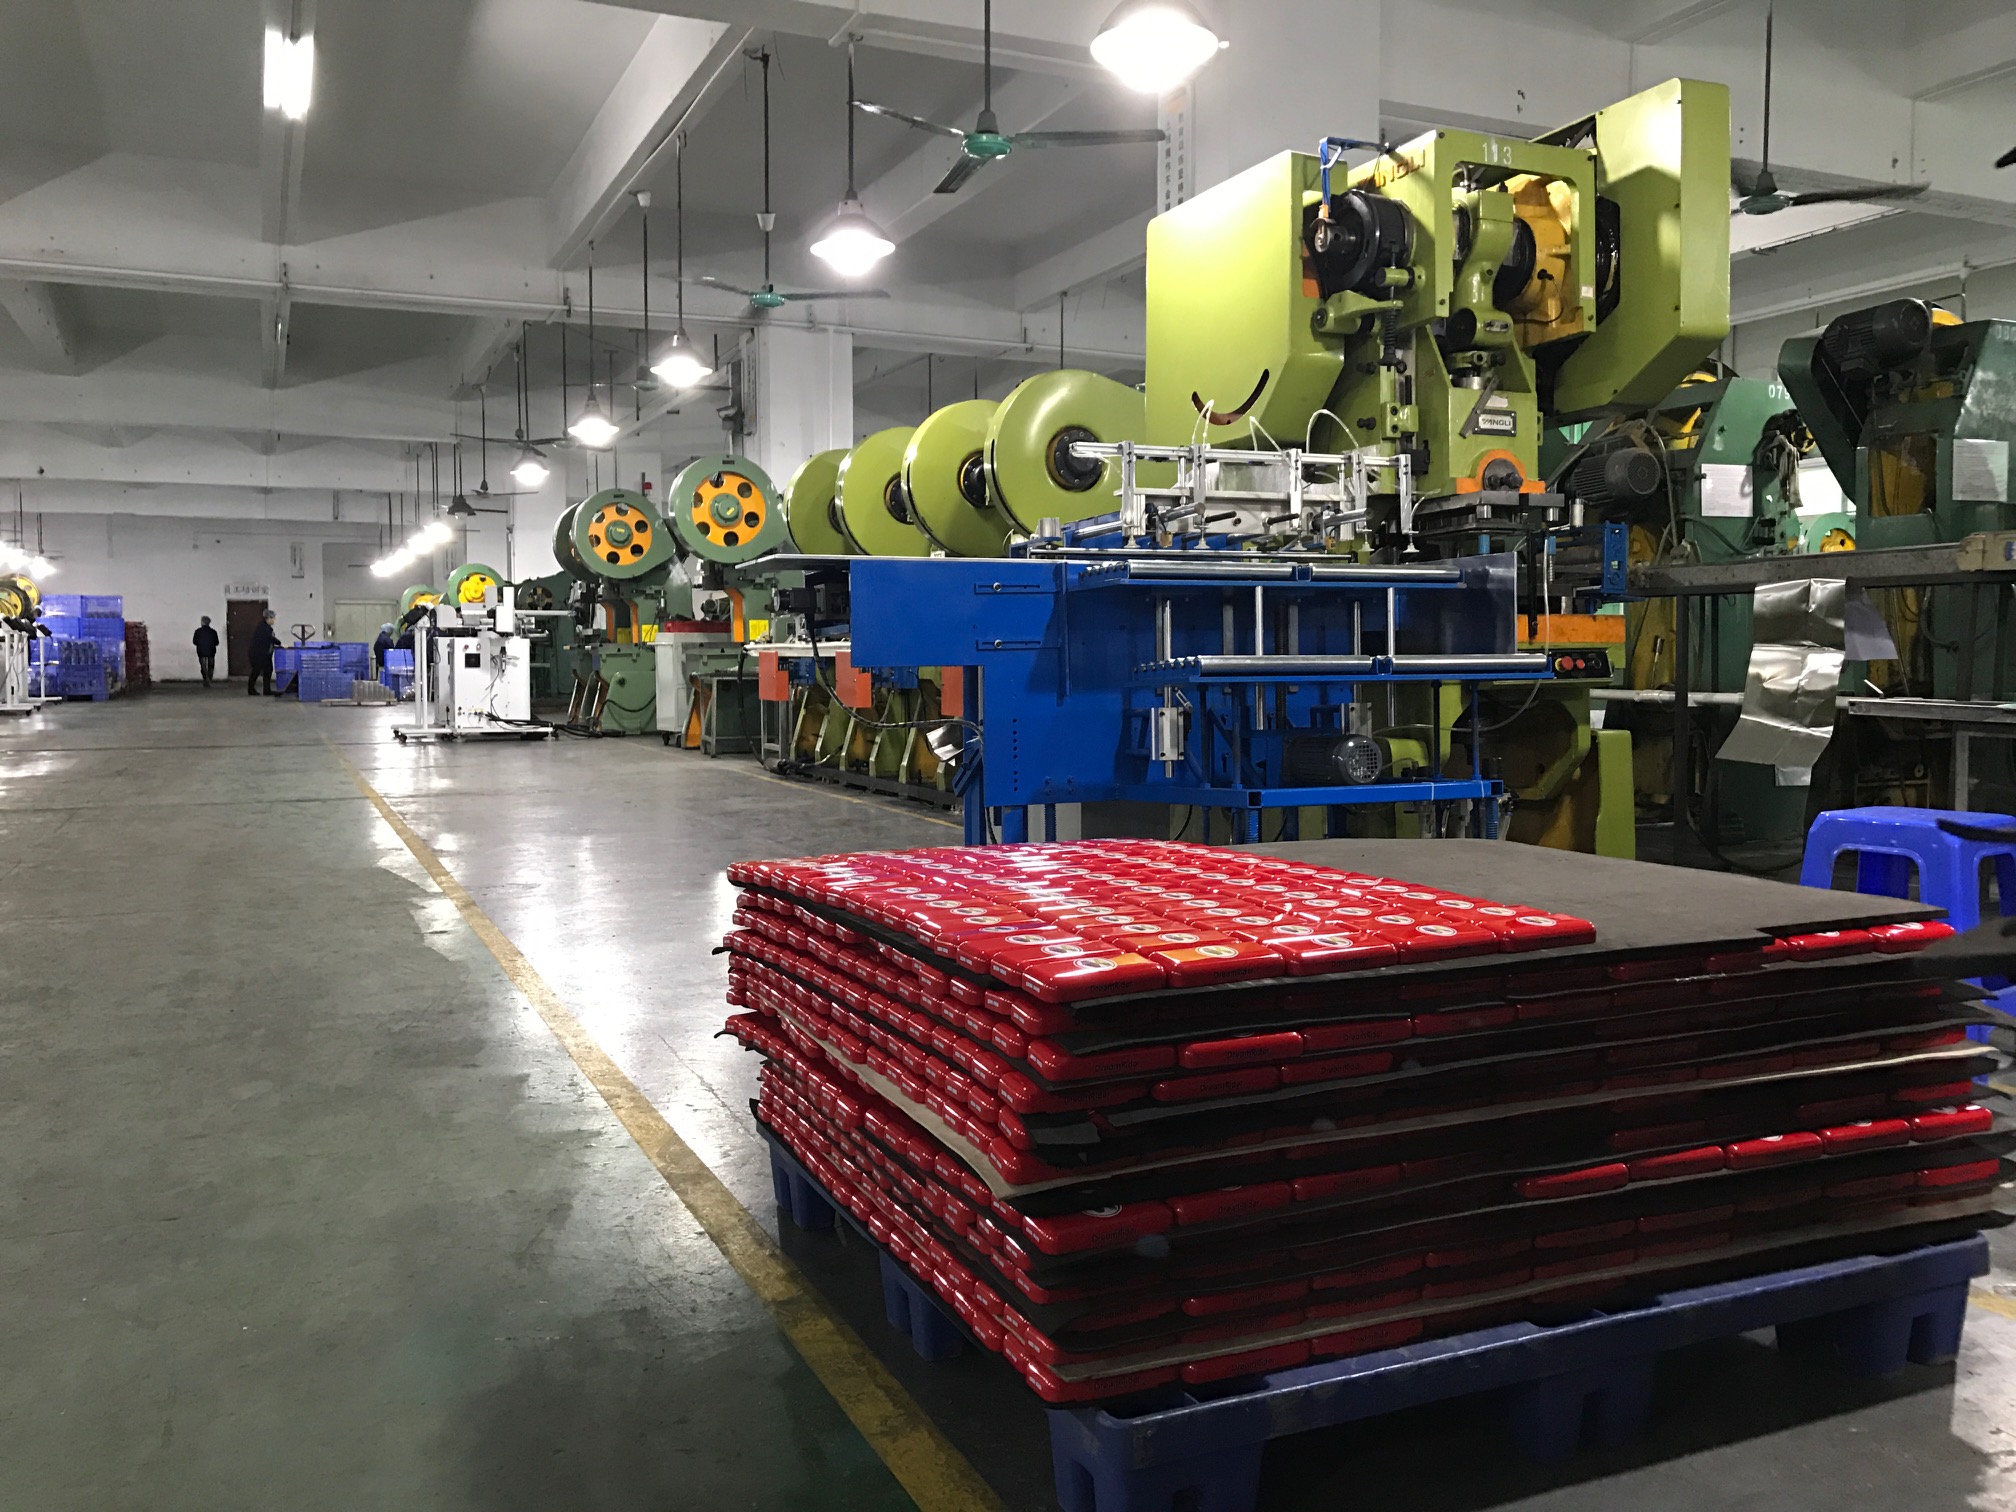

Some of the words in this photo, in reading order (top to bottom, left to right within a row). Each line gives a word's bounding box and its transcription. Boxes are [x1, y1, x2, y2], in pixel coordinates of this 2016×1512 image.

[1482, 142, 1512, 166] 113
[1213, 967, 1254, 979] DreamRider
[1090, 979, 1134, 992] DreamRider
[1226, 1047, 1270, 1059] DreamRider
[1094, 1060, 1139, 1073] DreamRider
[1200, 1078, 1243, 1091] DreamRider
